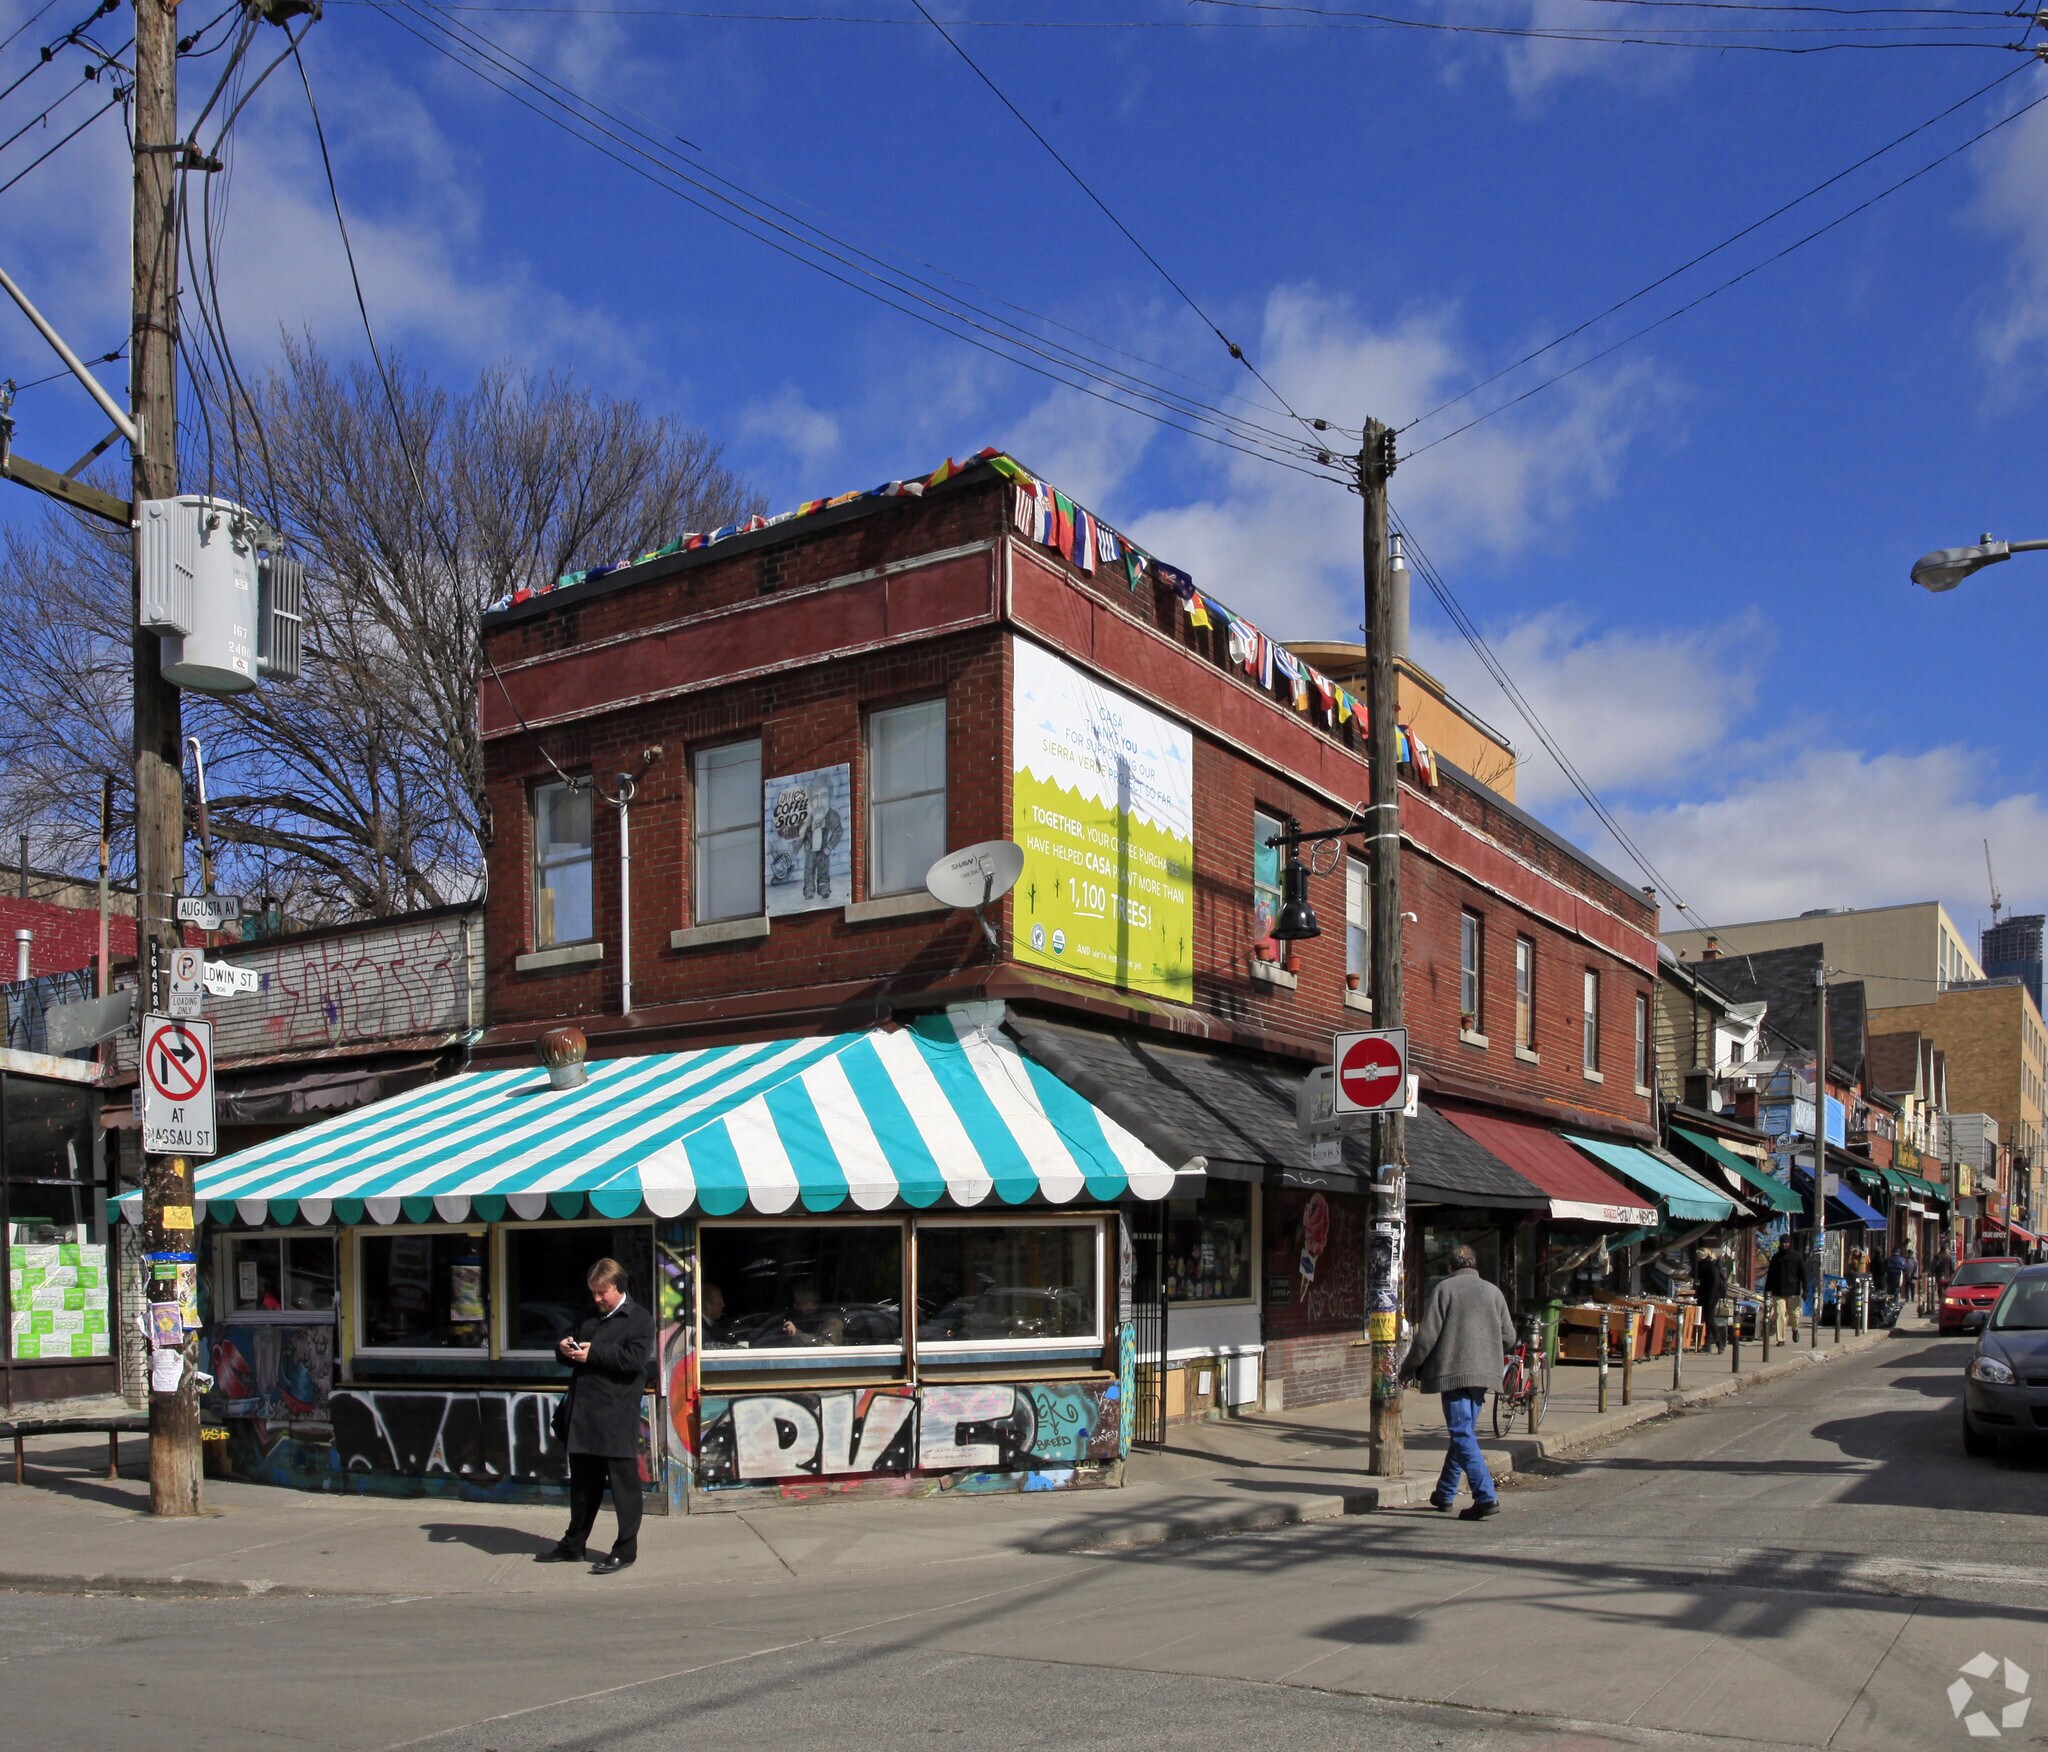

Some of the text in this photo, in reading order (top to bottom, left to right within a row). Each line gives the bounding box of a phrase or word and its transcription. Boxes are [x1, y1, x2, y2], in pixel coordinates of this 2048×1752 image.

[233, 623, 248, 639] 167
[228, 640, 252, 659] 2400
[1099, 707, 1124, 730] CASA
[1085, 718, 1138, 754] THANKS YOU
[1065, 728, 1156, 780] FOR SUPPORTING OUR
[1042, 739, 1075, 763] SIERRA
[1078, 754, 1107, 777] VERDE
[1108, 767, 1144, 795] PROJECT
[1145, 784, 1157, 800] SO
[773, 798, 809, 818] COFFEE
[775, 810, 808, 829] STOP
[1031, 805, 1180, 877] TOGETHER, YOUR COFFEE PURCHASES
[1027, 835, 1185, 904] HAVE HELPED CASA PLANT MORE THAN
[181, 901, 222, 916] AUGUSTA
[1068, 877, 1152, 930] 1,100 TREES!
[1076, 943, 1091, 956] AND
[203, 966, 235, 985] LDWIN
[173, 997, 198, 1006] LOADING
[177, 1007, 192, 1015] ONLY
[171, 1107, 185, 1123] AT
[196, 1130, 210, 1146] ST
